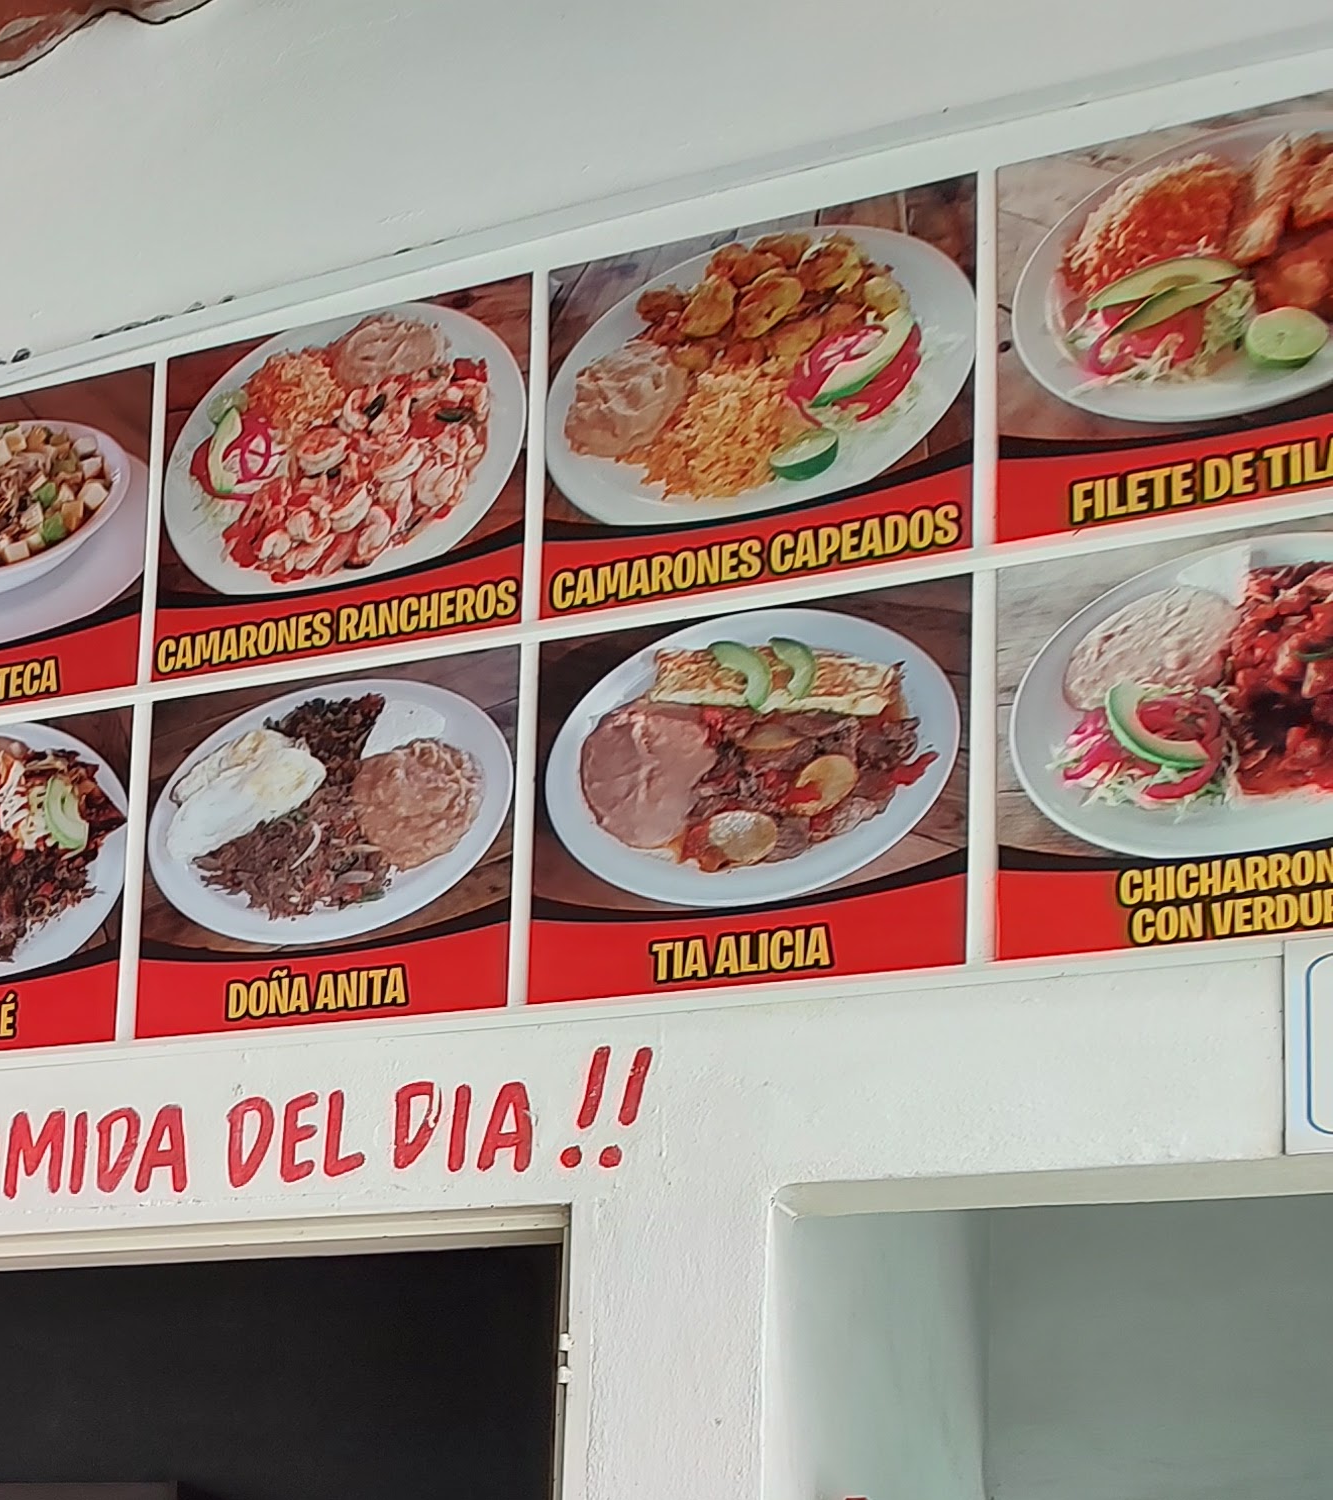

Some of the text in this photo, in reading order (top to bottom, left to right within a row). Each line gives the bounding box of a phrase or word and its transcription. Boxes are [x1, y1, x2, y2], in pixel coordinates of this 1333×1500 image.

[1071, 462, 1195, 524] FILETE
[1201, 451, 1257, 501] DE
[551, 504, 960, 611] CAMARONES CAPEADOS
[156, 579, 518, 674] CAMARONES RANCHEROS
[650, 926, 831, 982] TIA ALICIA
[1131, 902, 1204, 945] CON
[226, 966, 407, 1021] DOÑA ANITA
[226, 1090, 367, 1190] DEL
